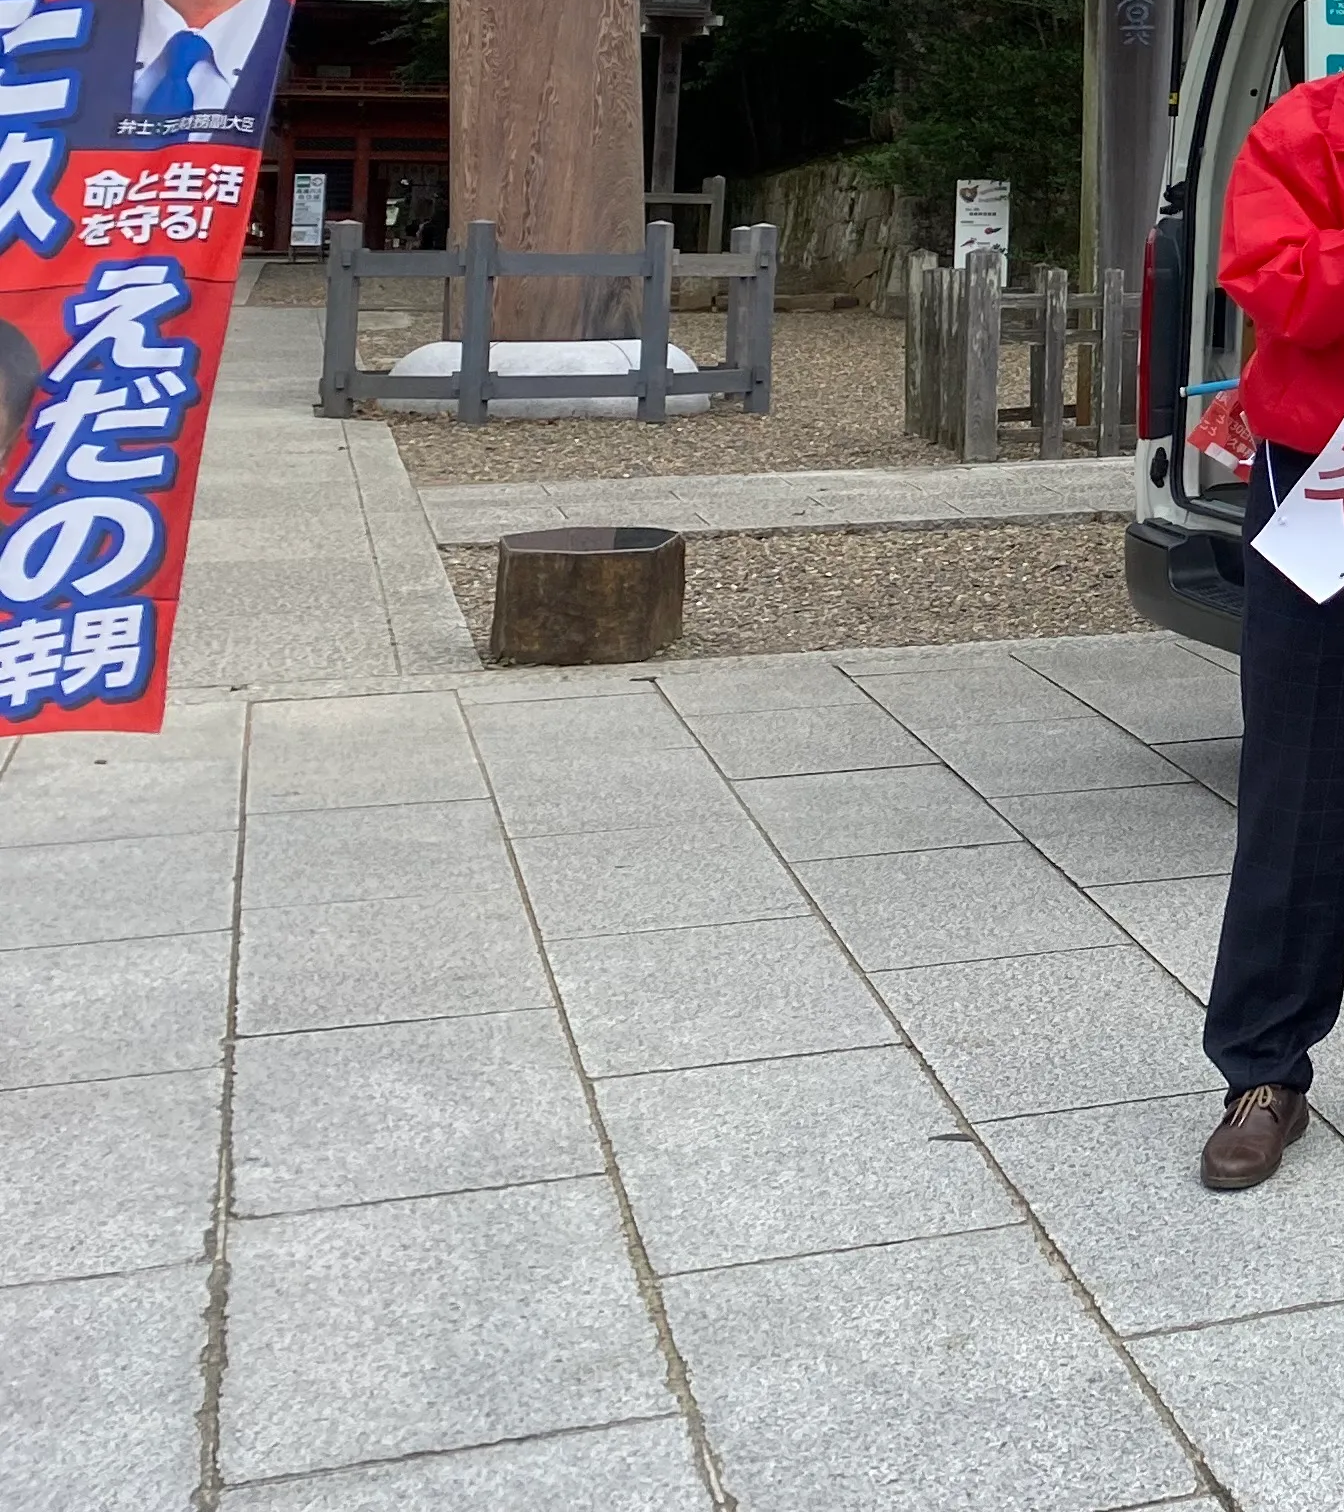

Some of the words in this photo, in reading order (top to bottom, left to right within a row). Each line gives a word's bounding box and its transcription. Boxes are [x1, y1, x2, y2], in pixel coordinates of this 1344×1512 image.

[117, 114, 256, 136] 弁士：元財務副大臣
[83, 162, 245, 210] 命と生活
[78, 204, 214, 247] を守る！
